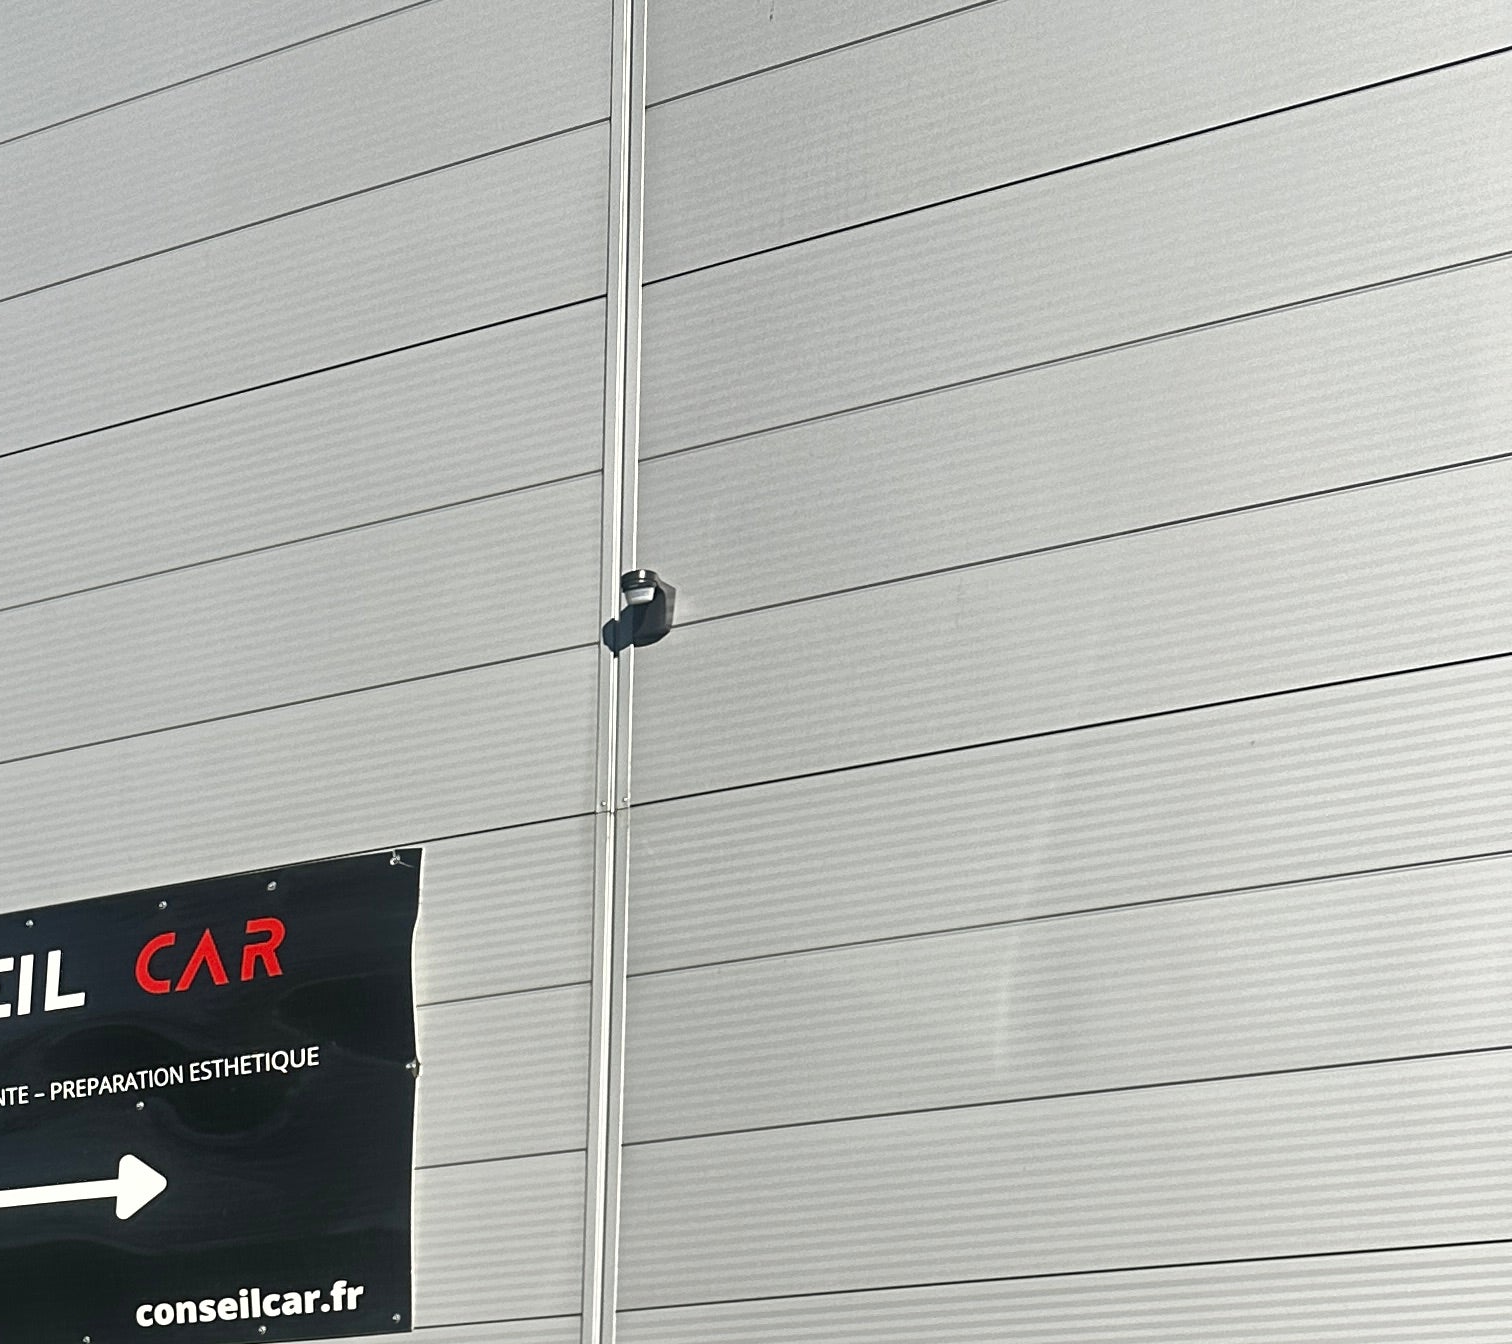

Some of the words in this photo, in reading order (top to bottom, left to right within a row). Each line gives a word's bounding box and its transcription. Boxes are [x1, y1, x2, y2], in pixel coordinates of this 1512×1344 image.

[134, 917, 286, 995] CAR
[50, 1064, 184, 1101] PREPARATION
[189, 1046, 320, 1082] ESTHETIQUE
[135, 1279, 365, 1327] conseilcar.fr
